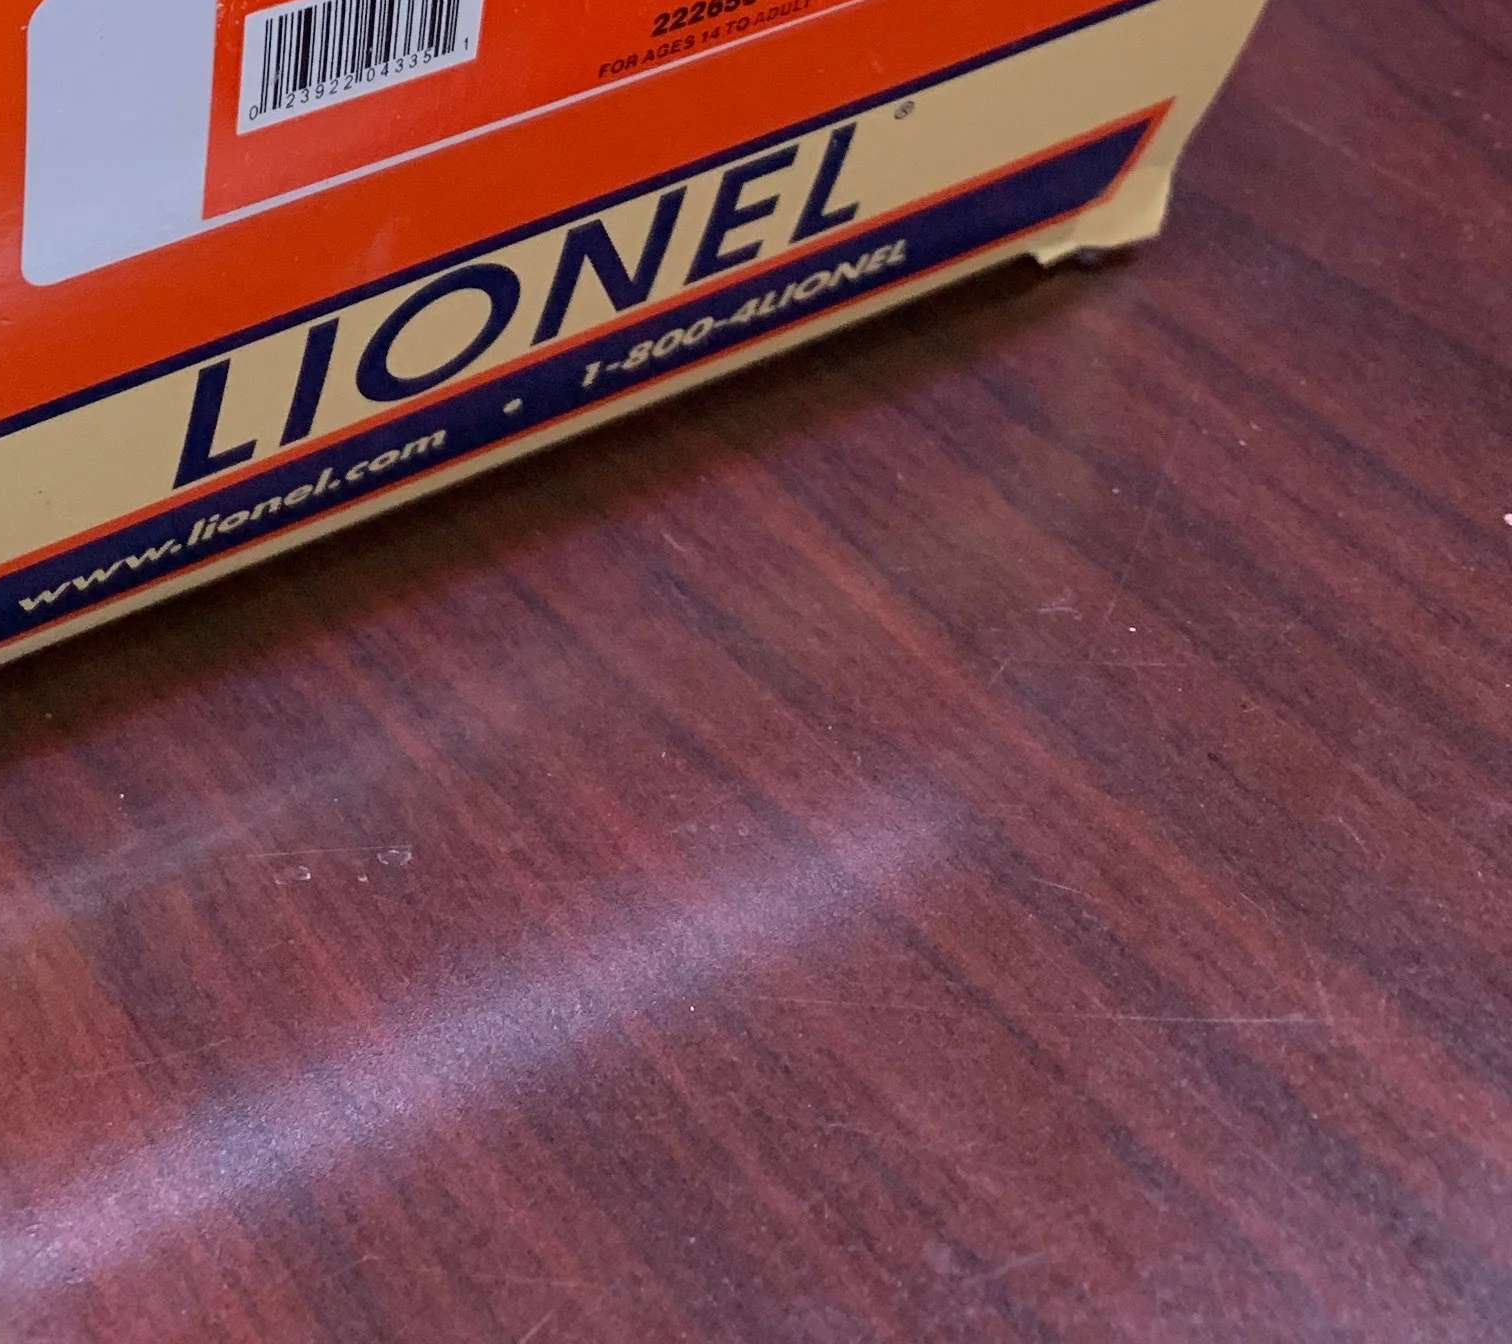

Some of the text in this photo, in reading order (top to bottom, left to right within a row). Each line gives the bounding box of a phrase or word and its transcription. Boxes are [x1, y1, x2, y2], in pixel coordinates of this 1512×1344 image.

[248, 105, 260, 121] 0
[285, 75, 355, 110] 23922
[366, 48, 433, 83] 04335
[598, 52, 639, 79] FOR
[641, 34, 696, 64] AGES
[701, 25, 721, 44] 14
[725, 15, 751, 36] TO
[171, 122, 861, 492] LIONEL
[18, 238, 907, 613] www.lionel.com 1-800-4LIONEL
